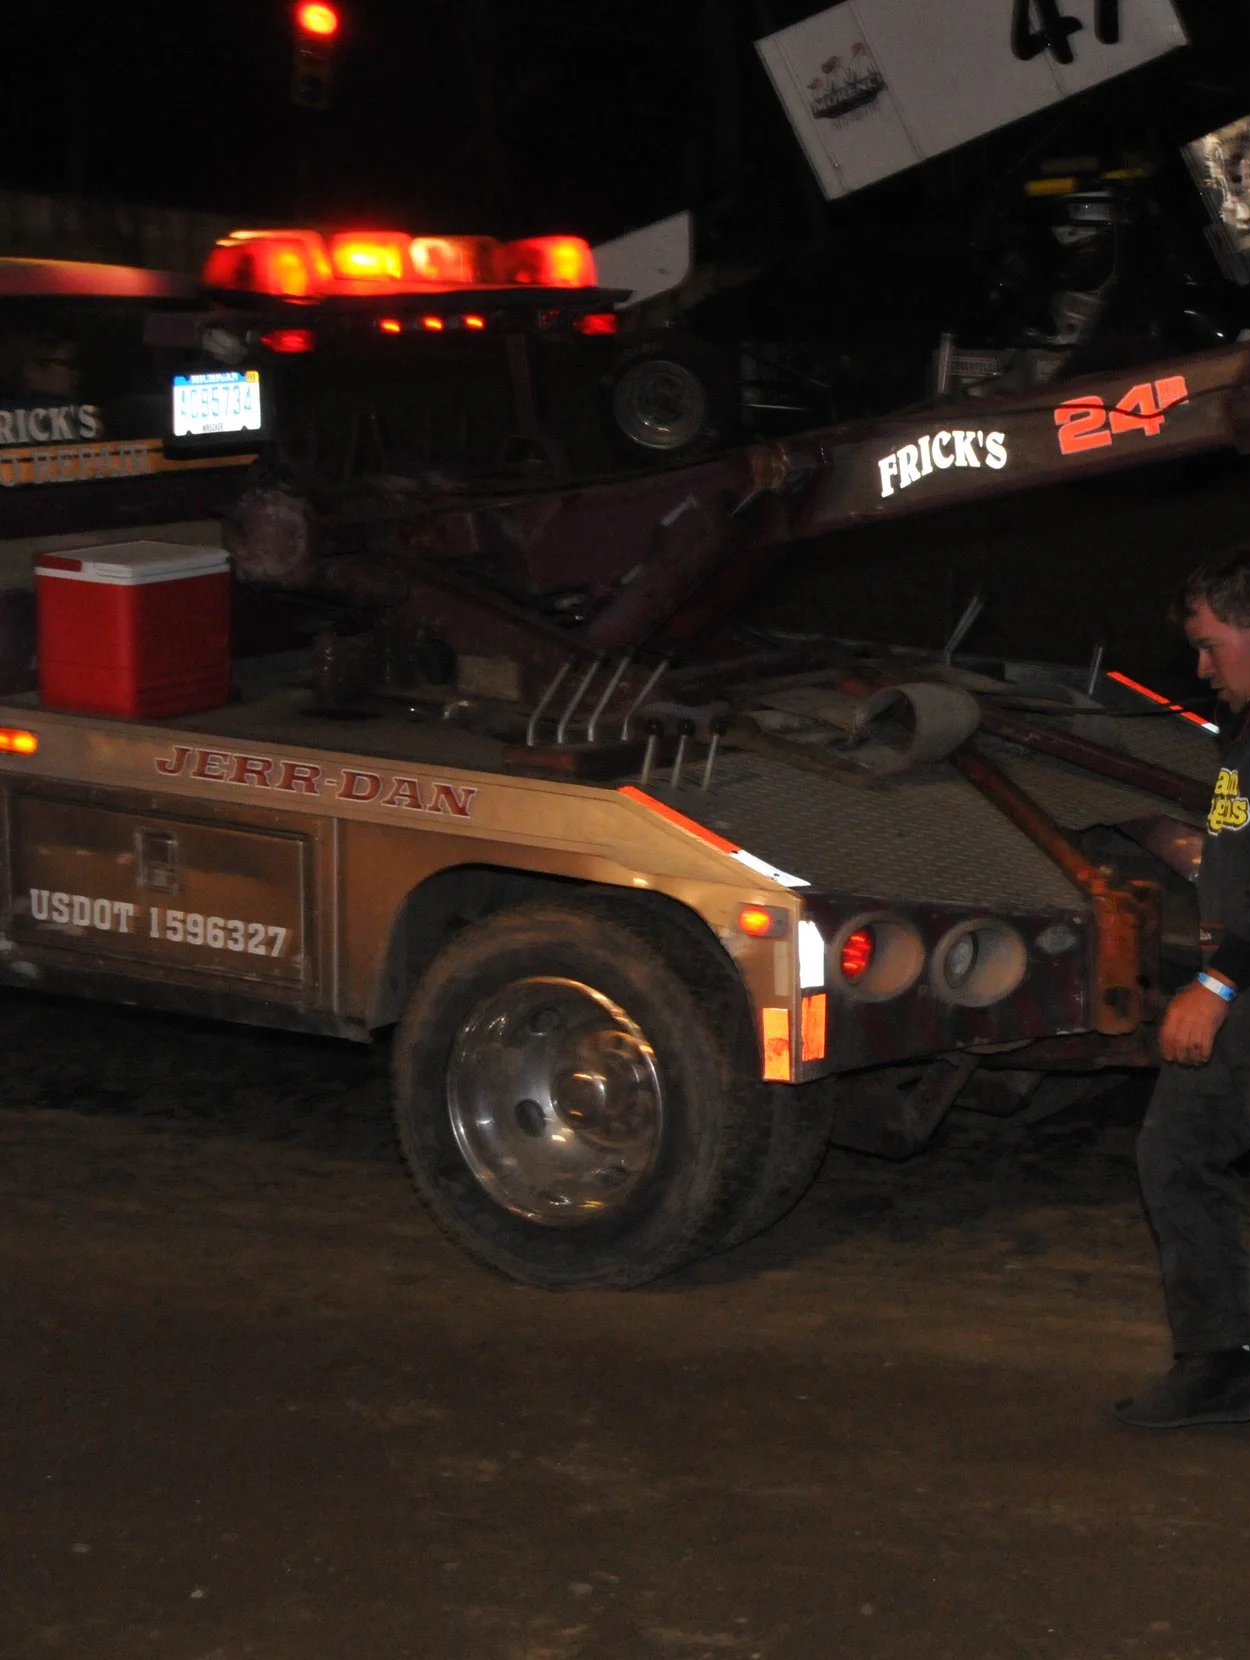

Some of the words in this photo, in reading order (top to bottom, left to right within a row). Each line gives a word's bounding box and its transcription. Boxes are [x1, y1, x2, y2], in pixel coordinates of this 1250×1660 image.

[32, 445, 150, 484] REPAIR
[878, 430, 1007, 498] FRICK'S
[154, 745, 478, 819] JERR-DAN
[30, 888, 134, 933] USDOT
[148, 906, 293, 958] 1596327
